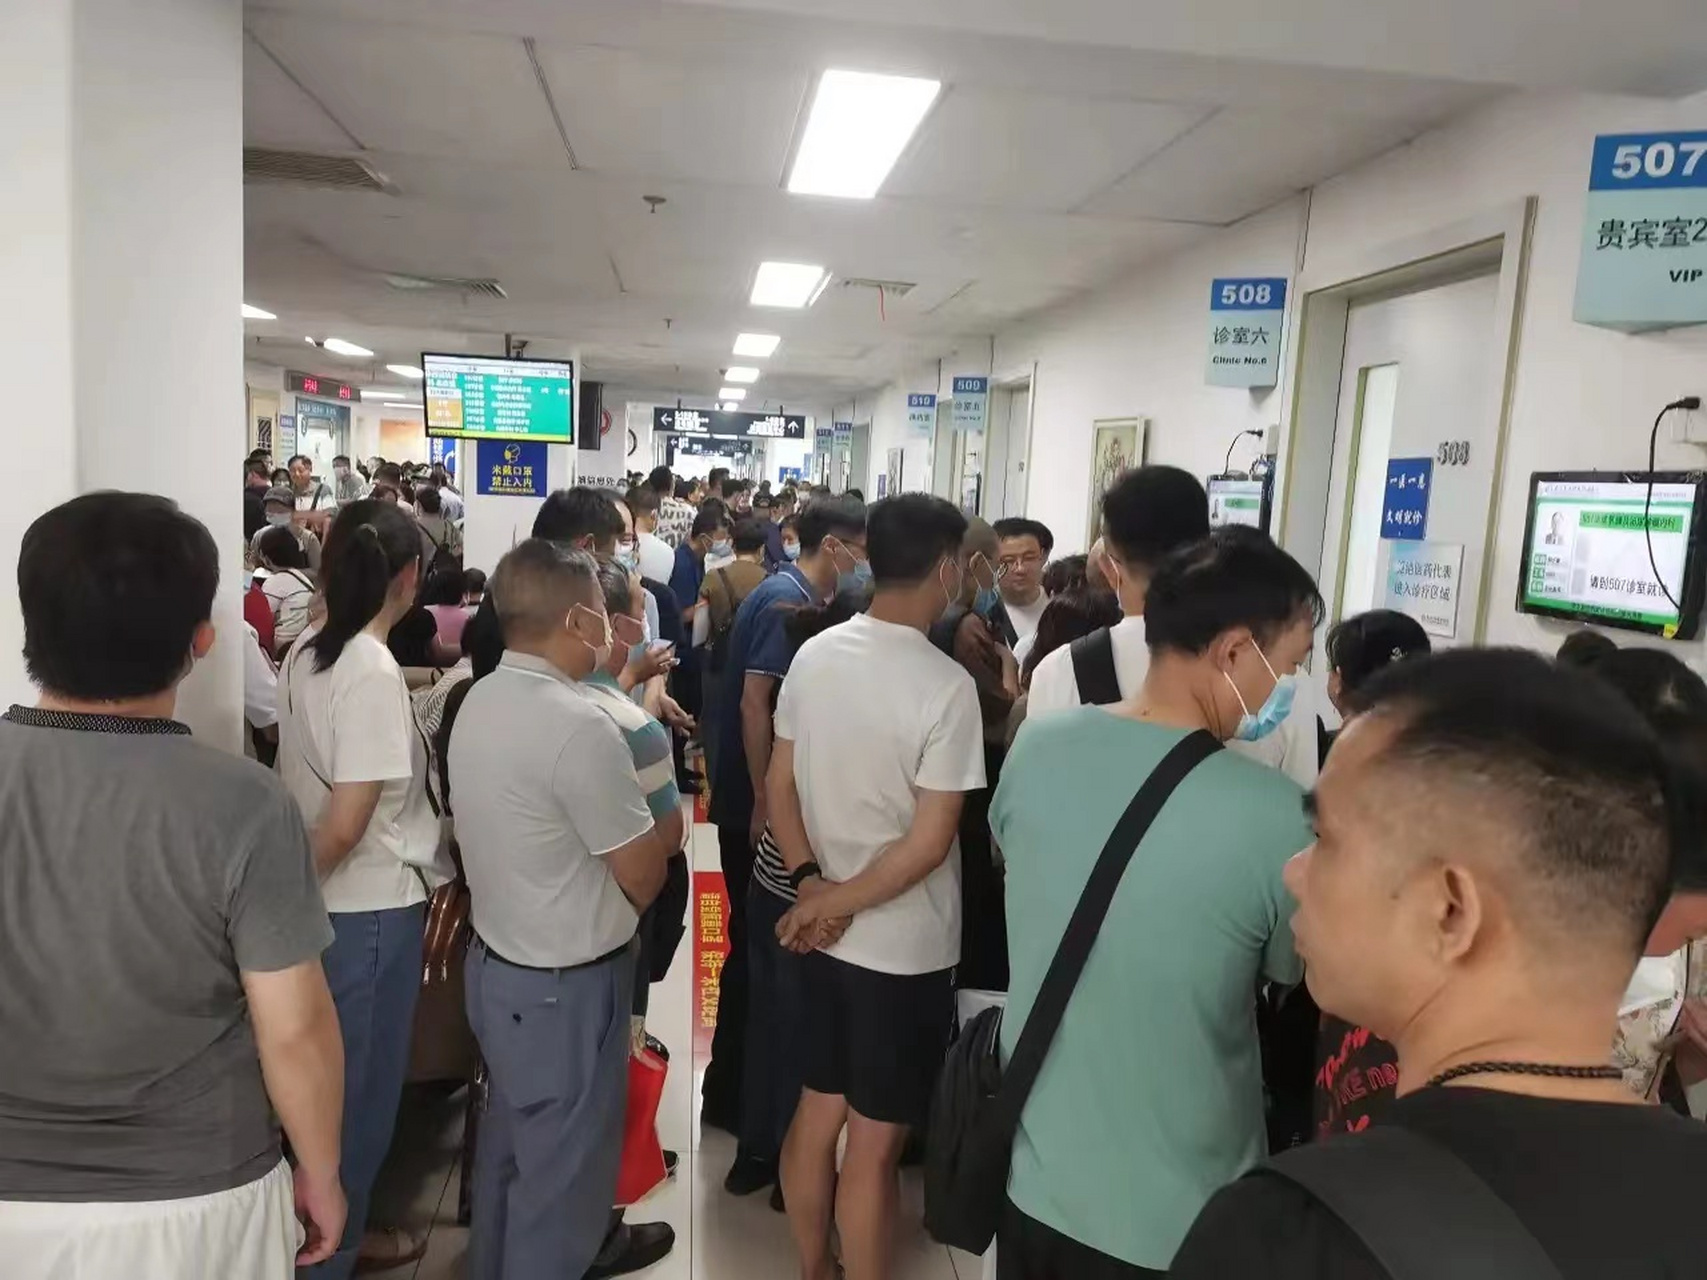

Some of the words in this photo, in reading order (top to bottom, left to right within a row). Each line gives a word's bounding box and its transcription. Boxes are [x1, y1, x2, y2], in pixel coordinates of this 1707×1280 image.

[1612, 142, 1706, 179] 507
[1597, 217, 1707, 250] 贵宾室2
[1669, 269, 1703, 283] VIP
[1221, 284, 1271, 305] 508
[1213, 326, 1269, 345] 诊室六
[1438, 441, 1471, 465] 508
[492, 476, 533, 488] 禁止入内
[1386, 509, 1422, 526] 文明就诊
[1394, 581, 1450, 601] 进入诊疗区域
